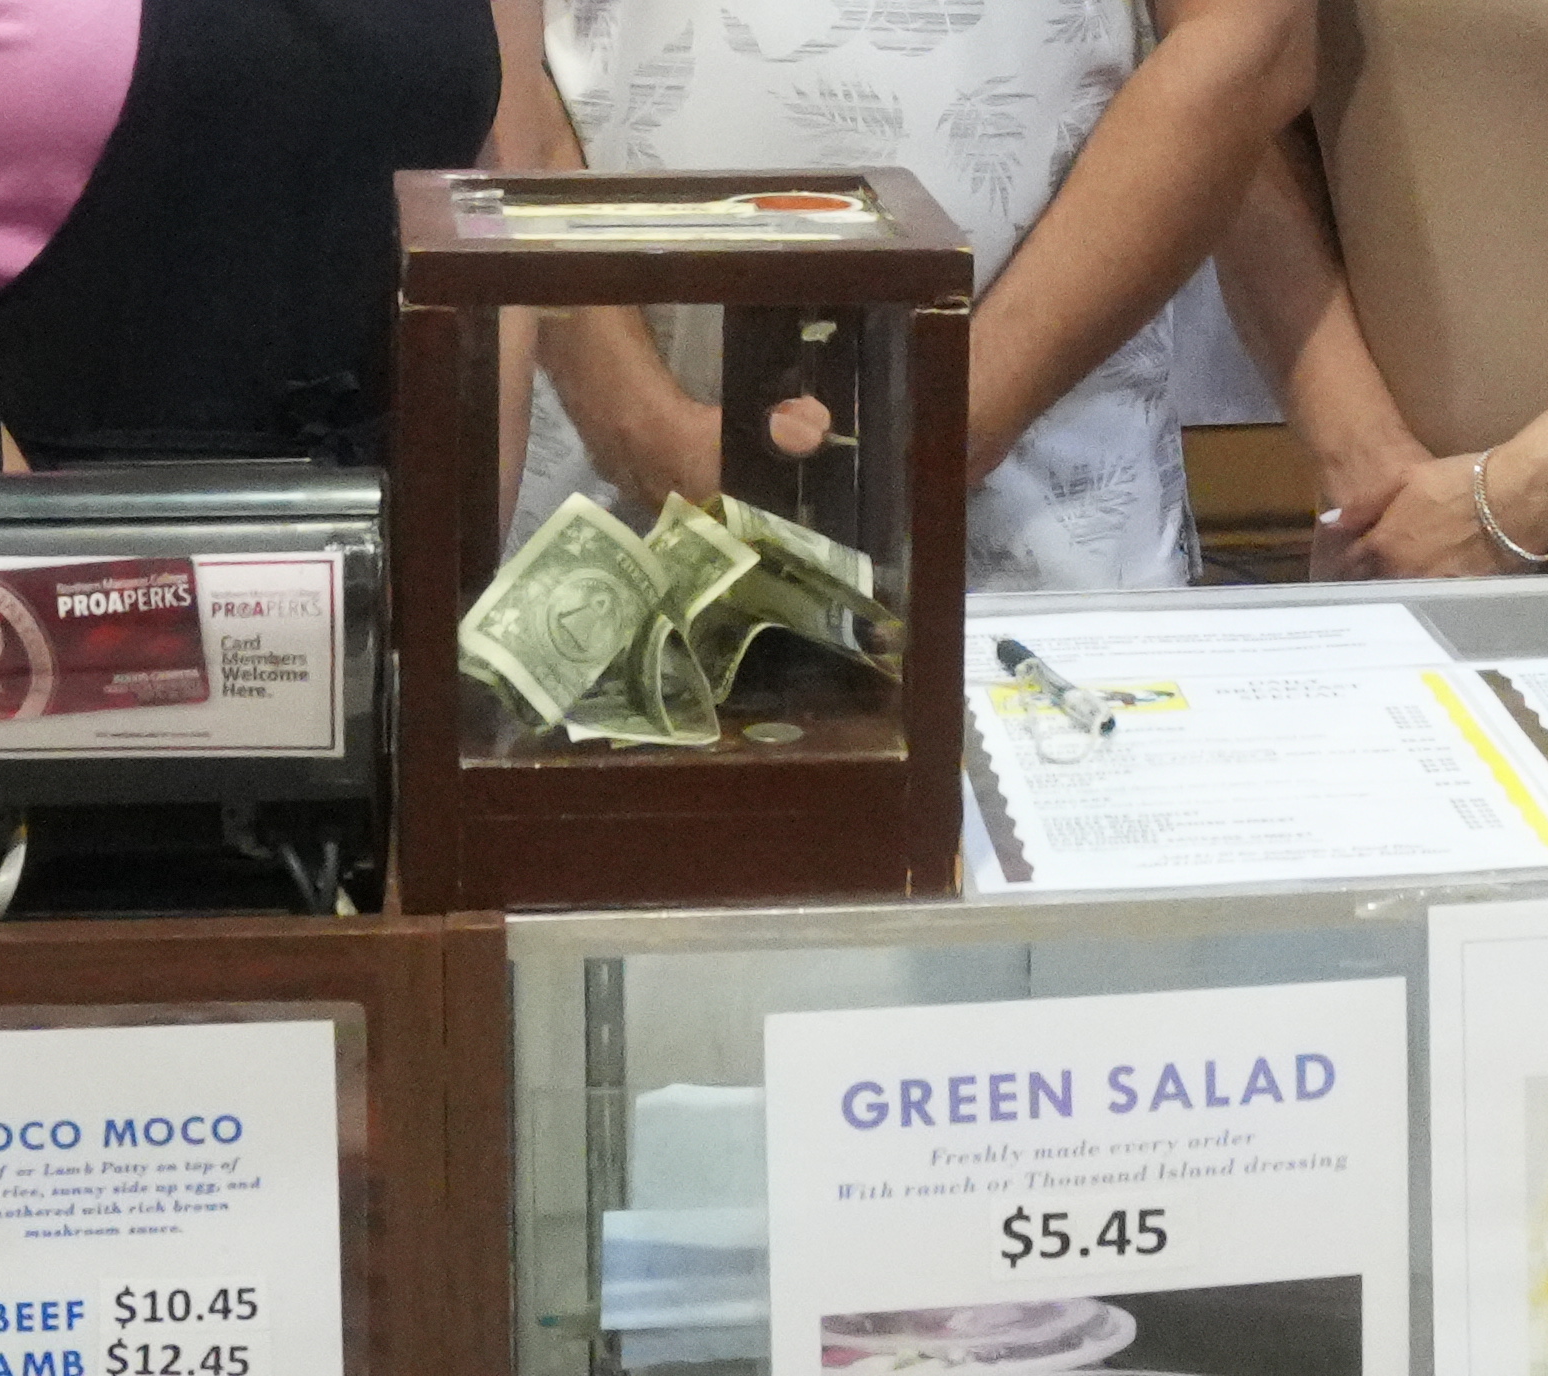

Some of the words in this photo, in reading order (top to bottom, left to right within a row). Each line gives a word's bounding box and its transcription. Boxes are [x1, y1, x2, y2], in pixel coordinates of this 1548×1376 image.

[59, 584, 192, 617] PROAPERKS
[221, 635, 261, 650] Card
[221, 667, 309, 681] Welcome
[222, 682, 273, 698] Here.
[842, 1070, 1072, 1130] GREEN
[1108, 1054, 1335, 1114] SALAD
[104, 1115, 242, 1148] MOCO
[1002, 1206, 1167, 1268] $5.45
[115, 1287, 257, 1329] $10.45
